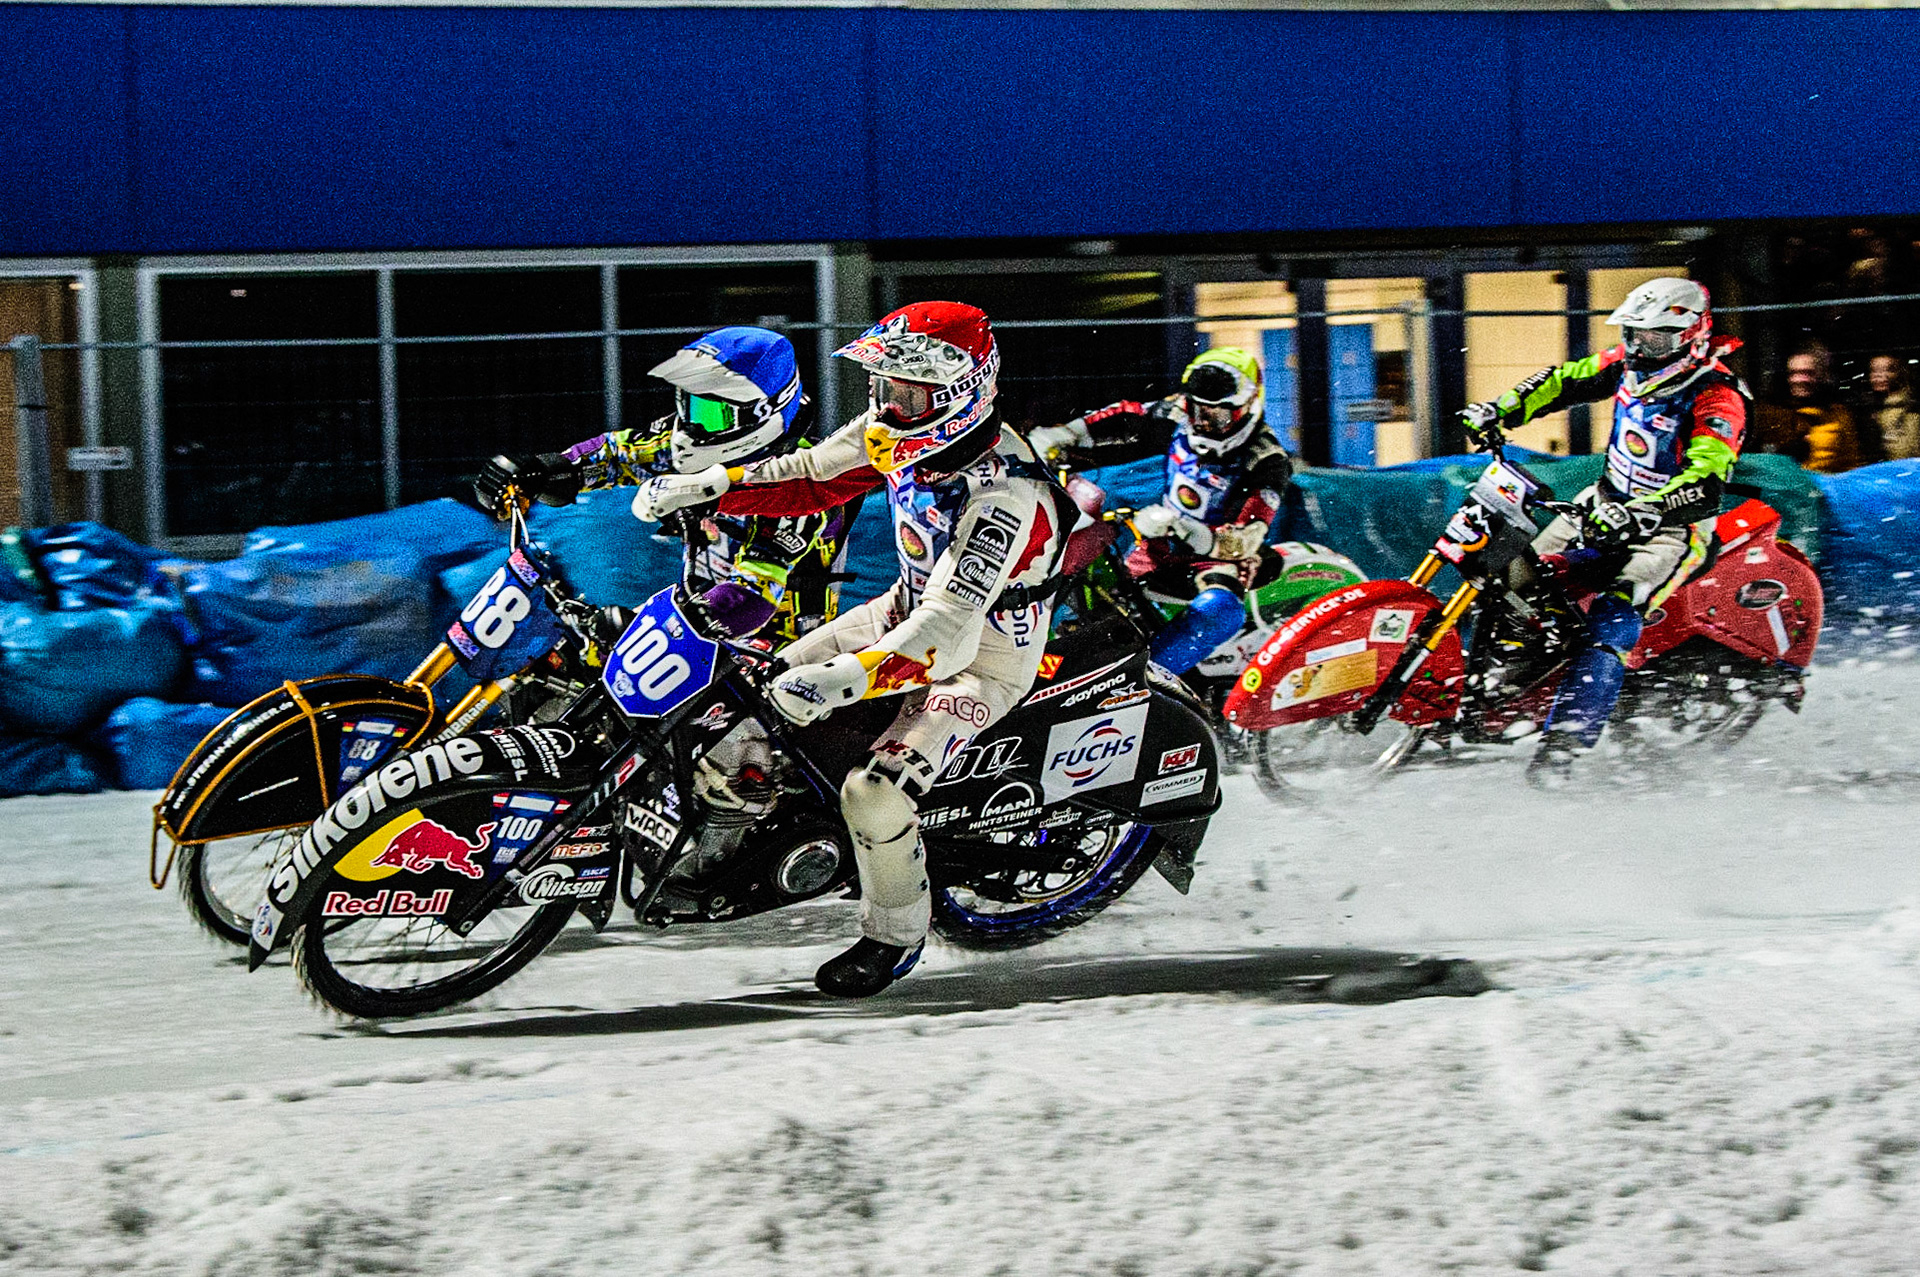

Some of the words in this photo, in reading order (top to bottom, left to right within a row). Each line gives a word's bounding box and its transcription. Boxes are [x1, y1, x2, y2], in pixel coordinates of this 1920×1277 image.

[461, 567, 531, 648] 88
[616, 615, 691, 701] 100
[1060, 673, 1126, 707] daytona
[348, 738, 381, 761] 88
[1050, 735, 1137, 771] FUCHS
[1152, 775, 1198, 792] WIMMER
[968, 807, 1043, 830] HINTSTEINER
[986, 798, 1031, 817] MAN
[497, 815, 543, 841] 100
[532, 877, 606, 898] Nilsson
[323, 889, 389, 915] Red
[389, 889, 453, 915] Bull
